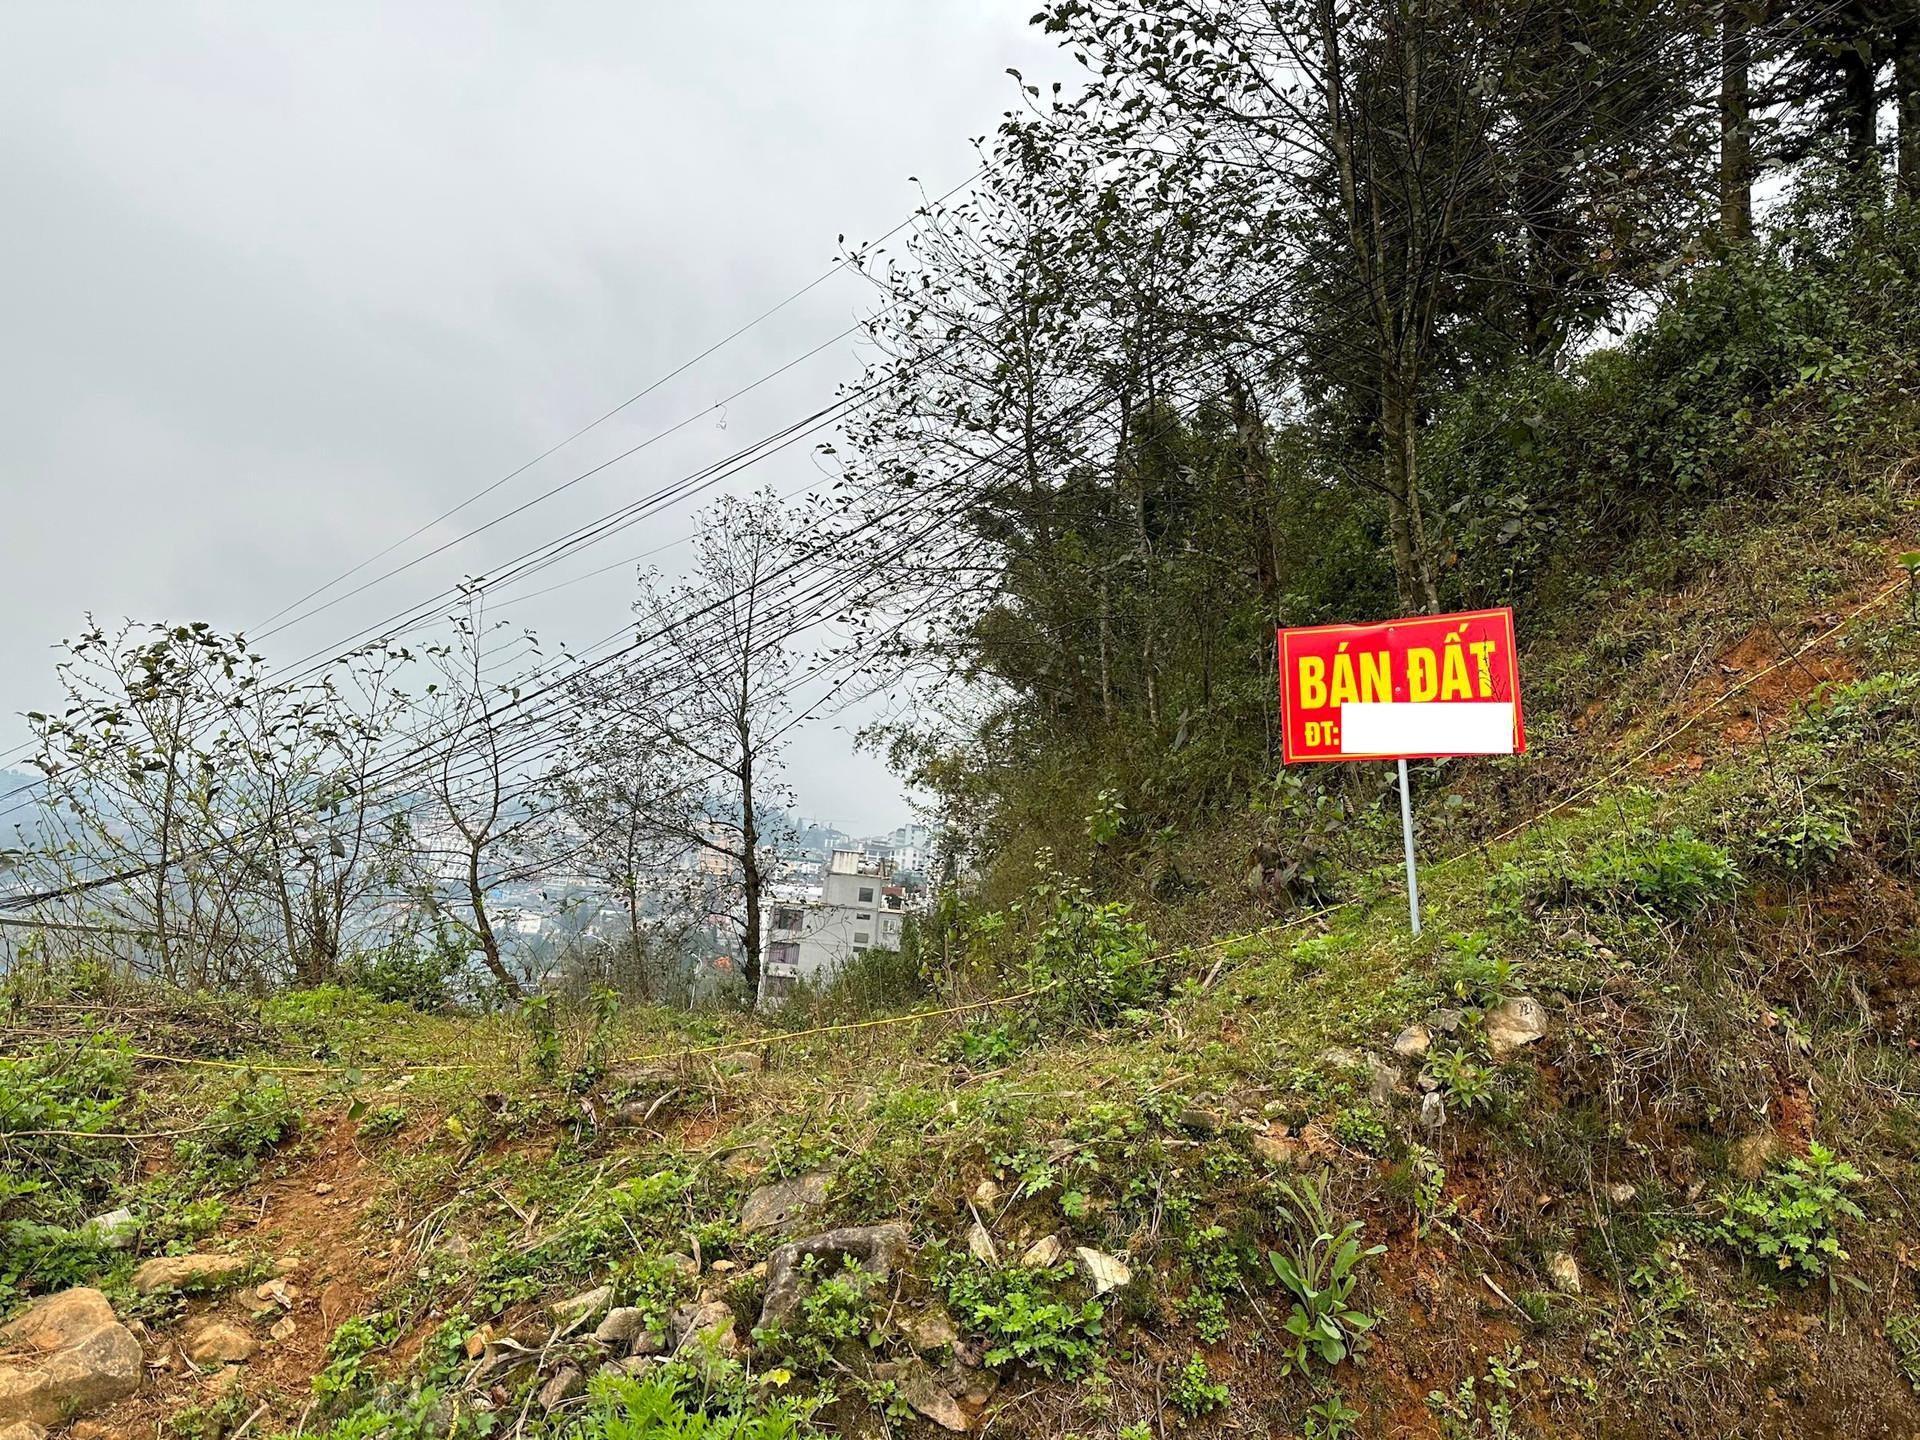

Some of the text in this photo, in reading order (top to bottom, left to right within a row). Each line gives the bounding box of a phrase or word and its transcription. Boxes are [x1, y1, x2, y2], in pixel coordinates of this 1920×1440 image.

[1298, 623, 1496, 709] BÁN ĐẤT
[1304, 721, 1339, 746] ĐT:
